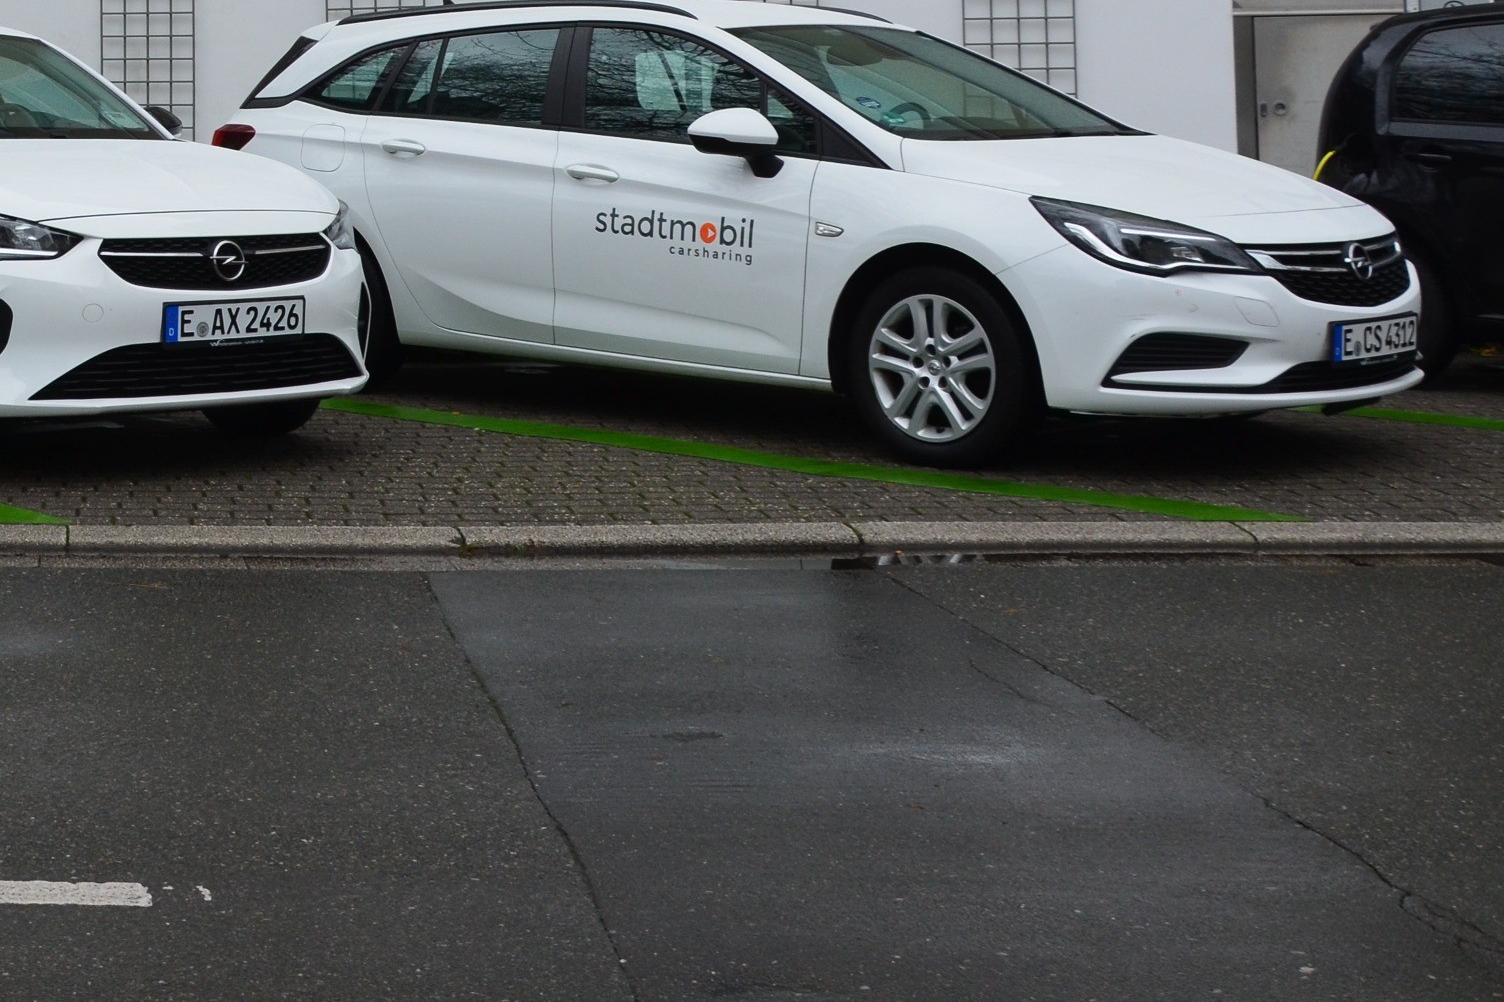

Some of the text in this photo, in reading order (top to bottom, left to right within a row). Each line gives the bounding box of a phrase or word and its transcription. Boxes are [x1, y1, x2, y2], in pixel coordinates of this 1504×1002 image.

[595, 207, 755, 248] stadtmobil
[669, 246, 753, 266] carsharing
[168, 328, 175, 336] D
[180, 309, 195, 337] E
[245, 304, 300, 334] 2426
[1344, 328, 1354, 356] E
[1363, 325, 1383, 353] CS
[1385, 320, 1415, 350] 4312
